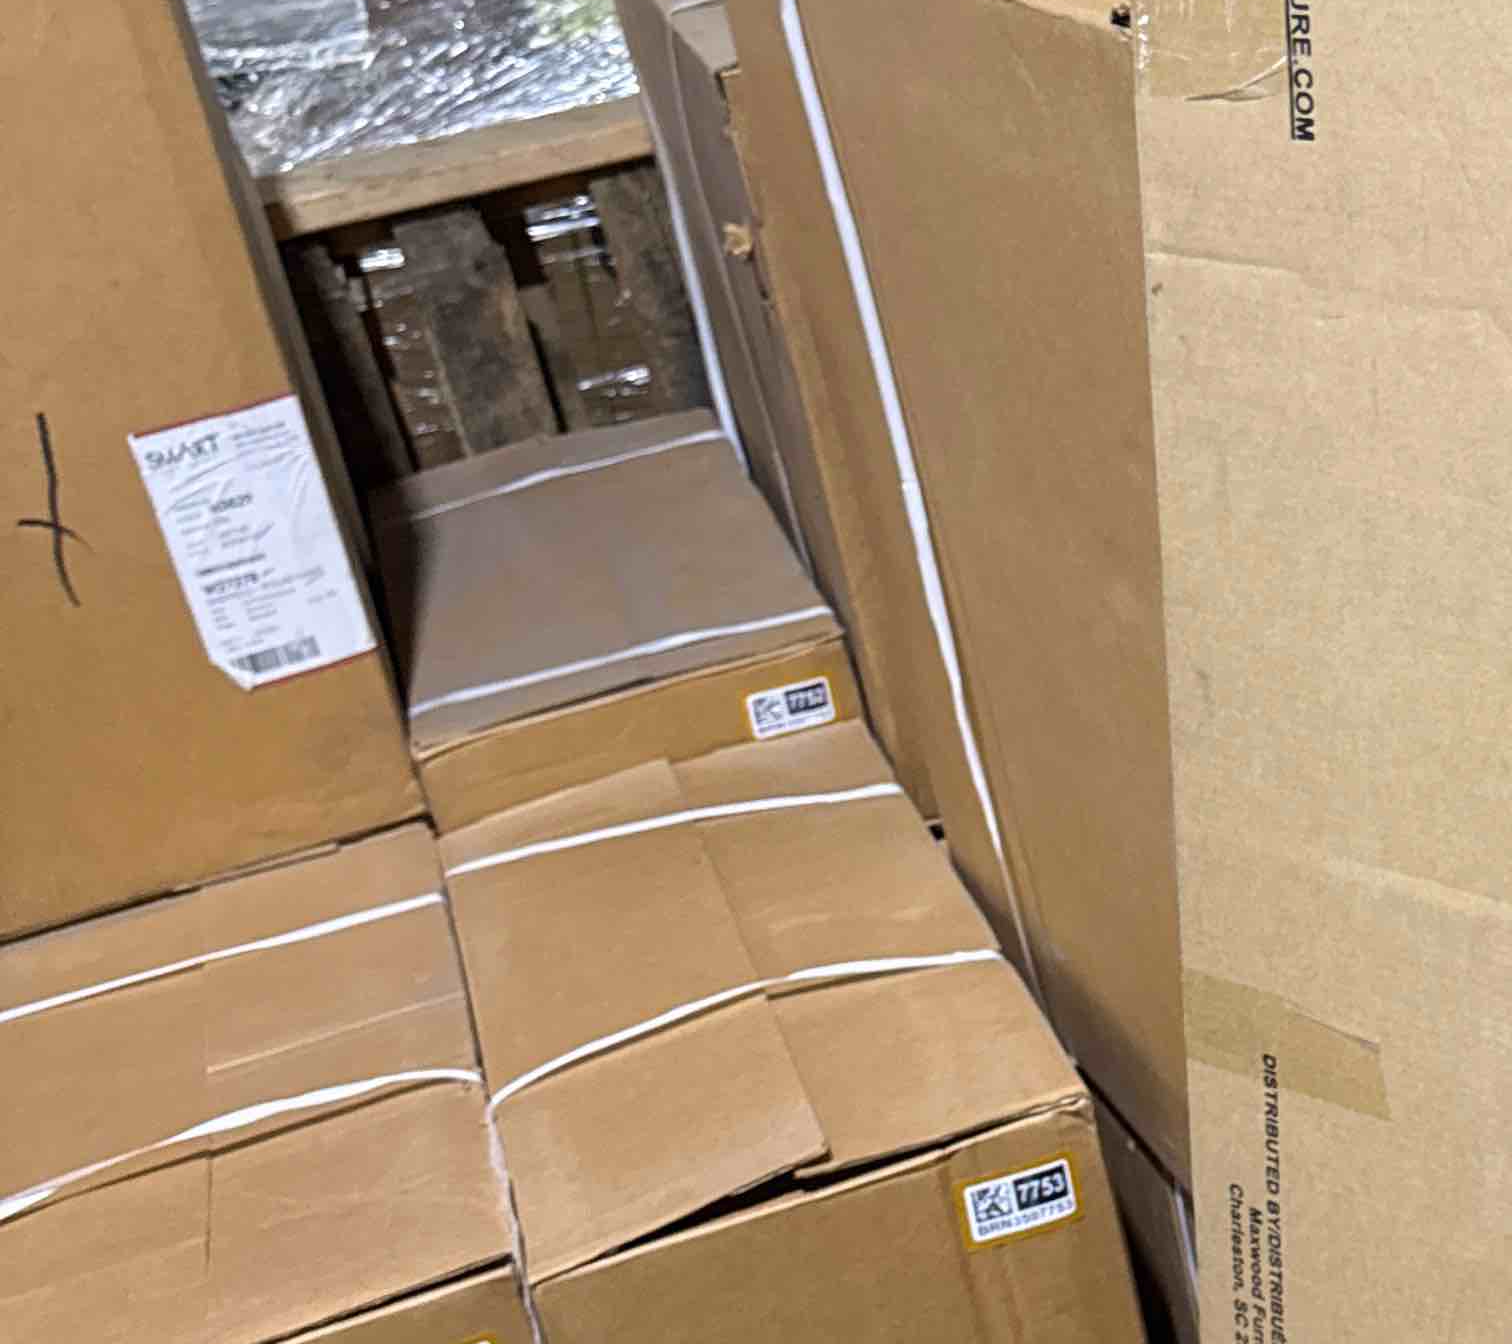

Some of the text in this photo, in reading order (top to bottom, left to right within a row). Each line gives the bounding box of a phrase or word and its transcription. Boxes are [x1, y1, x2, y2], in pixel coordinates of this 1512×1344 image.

[1262, 1053, 1280, 1193] DISTRIBUTED
[1017, 1172, 1064, 1203] 7753
[1248, 1207, 1266, 1299] Maxwood
[1234, 1299, 1248, 1329] SC
